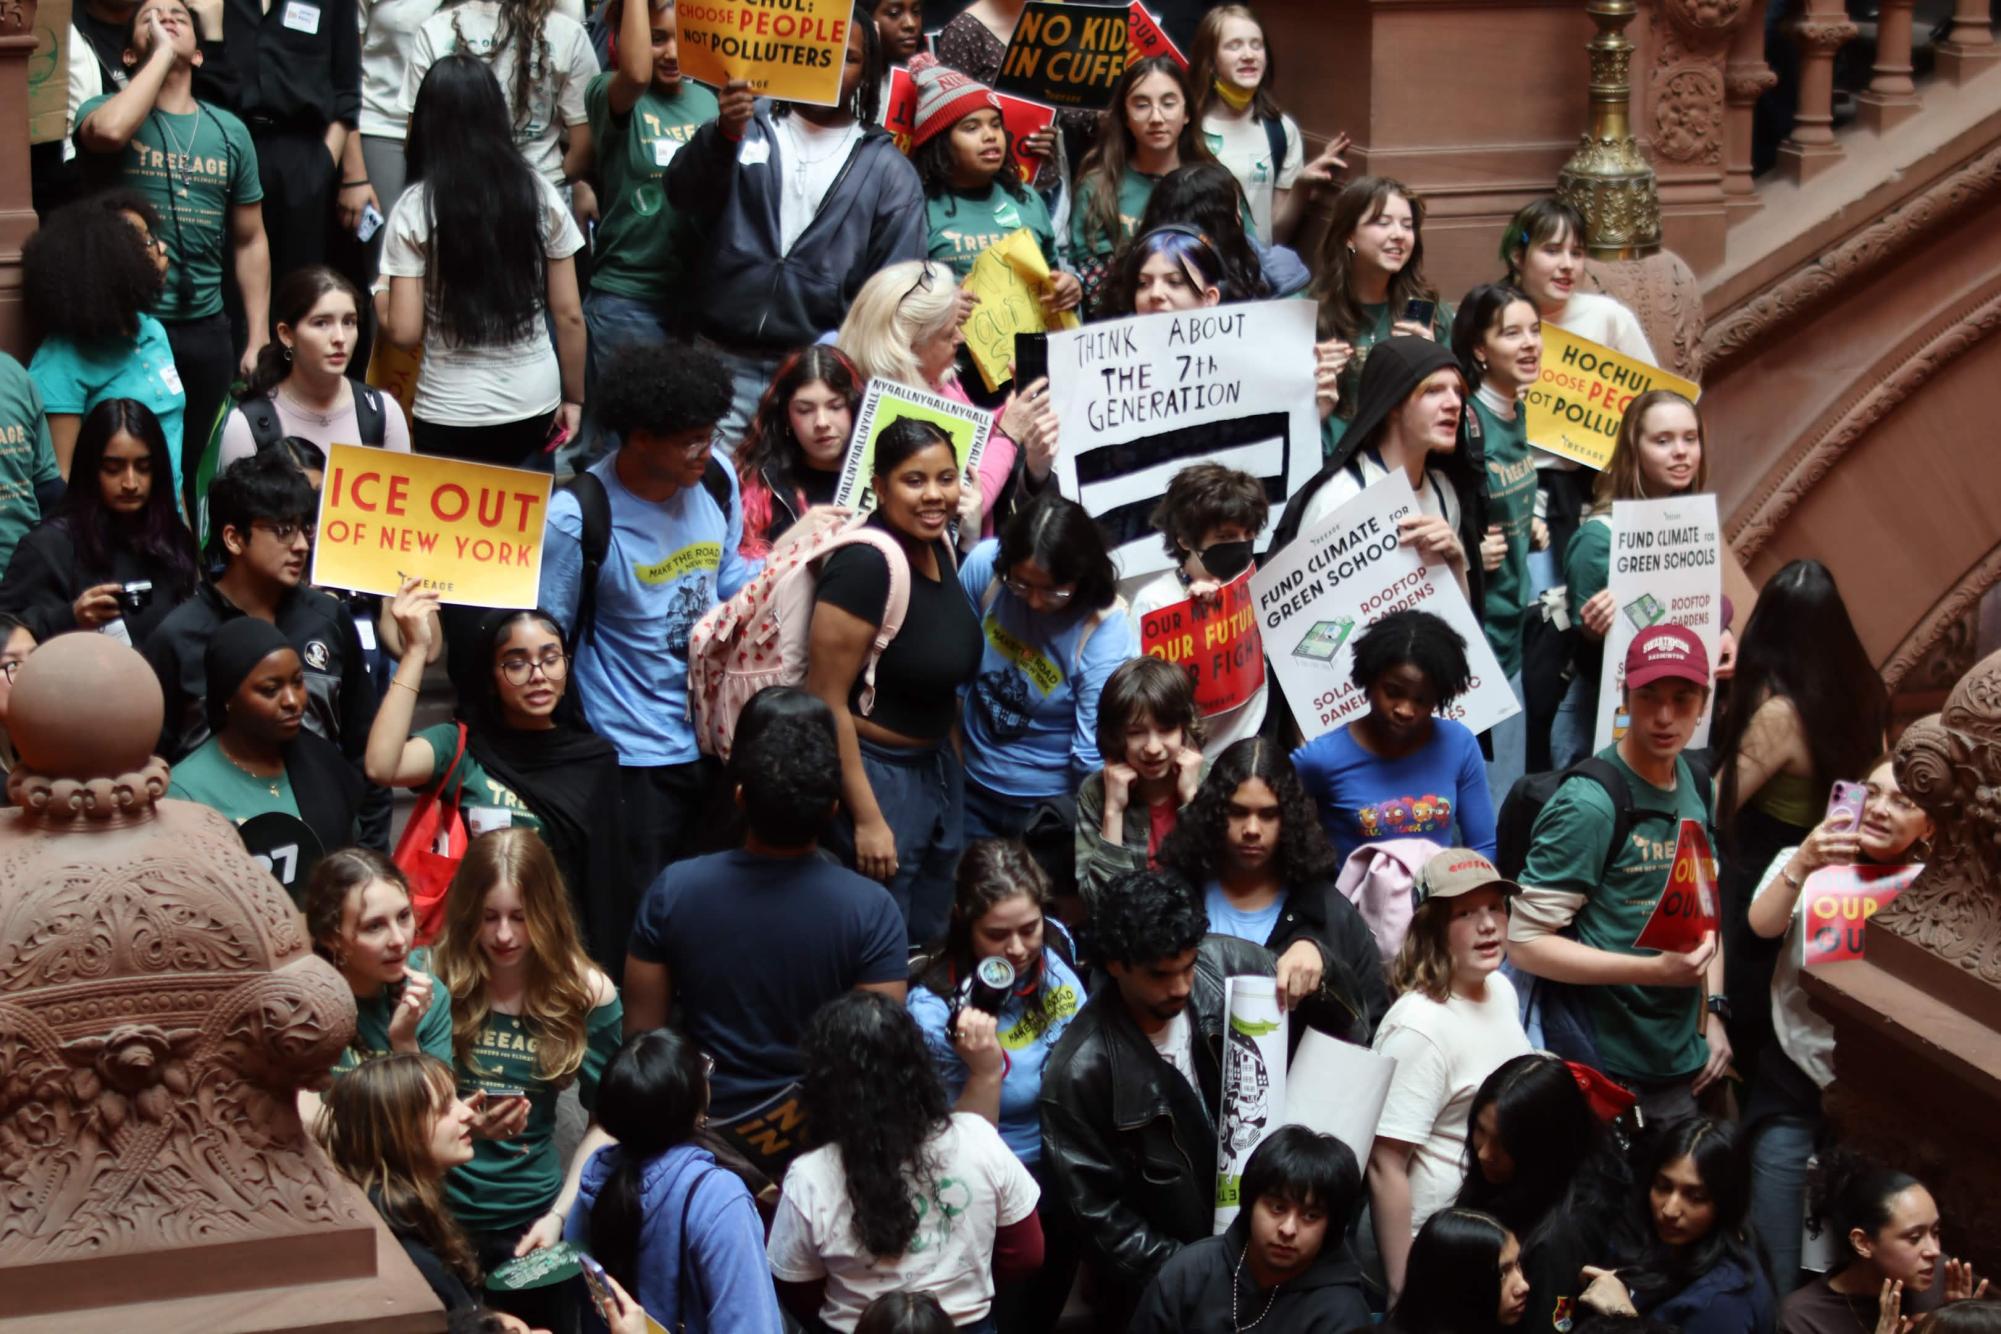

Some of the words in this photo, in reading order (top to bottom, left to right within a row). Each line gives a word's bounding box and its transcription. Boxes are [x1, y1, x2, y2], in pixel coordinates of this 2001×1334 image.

[679, 3, 735, 24] CHOOSE
[739, 9, 846, 44] PEOPLE
[1015, 11, 1073, 47] NO
[684, 28, 709, 47] NOT
[711, 33, 833, 69] POLLUTERS
[1002, 46, 1042, 79] IN
[1074, 325, 1138, 368] THINK
[1168, 313, 1246, 347] ABOUT
[1101, 363, 1152, 395] THE
[1176, 355, 1218, 382] 7th
[1542, 368, 1585, 392] OOSE
[1087, 380, 1241, 432] GENERATION
[1552, 397, 1620, 438] POLLU
[330, 467, 410, 517] ICE
[430, 482, 540, 533] OUT
[326, 519, 366, 545] OF
[379, 526, 439, 554] NEW
[455, 535, 532, 567] YORK
[1618, 531, 1654, 550] FUND
[1657, 526, 1699, 548] CLIMATE
[1704, 532, 1716, 541] FOR
[649, 561, 673, 578] MAKE
[672, 550, 693, 567] THE
[695, 547, 720, 558] ROAD
[1260, 569, 1304, 611] FUND
[1307, 516, 1381, 574] CLIMATE
[1388, 505, 1410, 524] FOR
[1266, 578, 1325, 629] GREEN
[1326, 525, 1402, 588] SCHOO
[1616, 554, 1661, 574] GREEN
[1663, 548, 1716, 571] SCHOOLS
[1359, 565, 1428, 616] ROOFTOP
[1671, 594, 1711, 611] ROOFTOP
[1145, 611, 1181, 639] OUR
[1204, 603, 1254, 651] FUTUR
[1034, 657, 1059, 684] ROAD
[1312, 681, 1359, 711] SOLA
[1320, 693, 1368, 727] PANEL
[1814, 926, 1864, 954] OU
